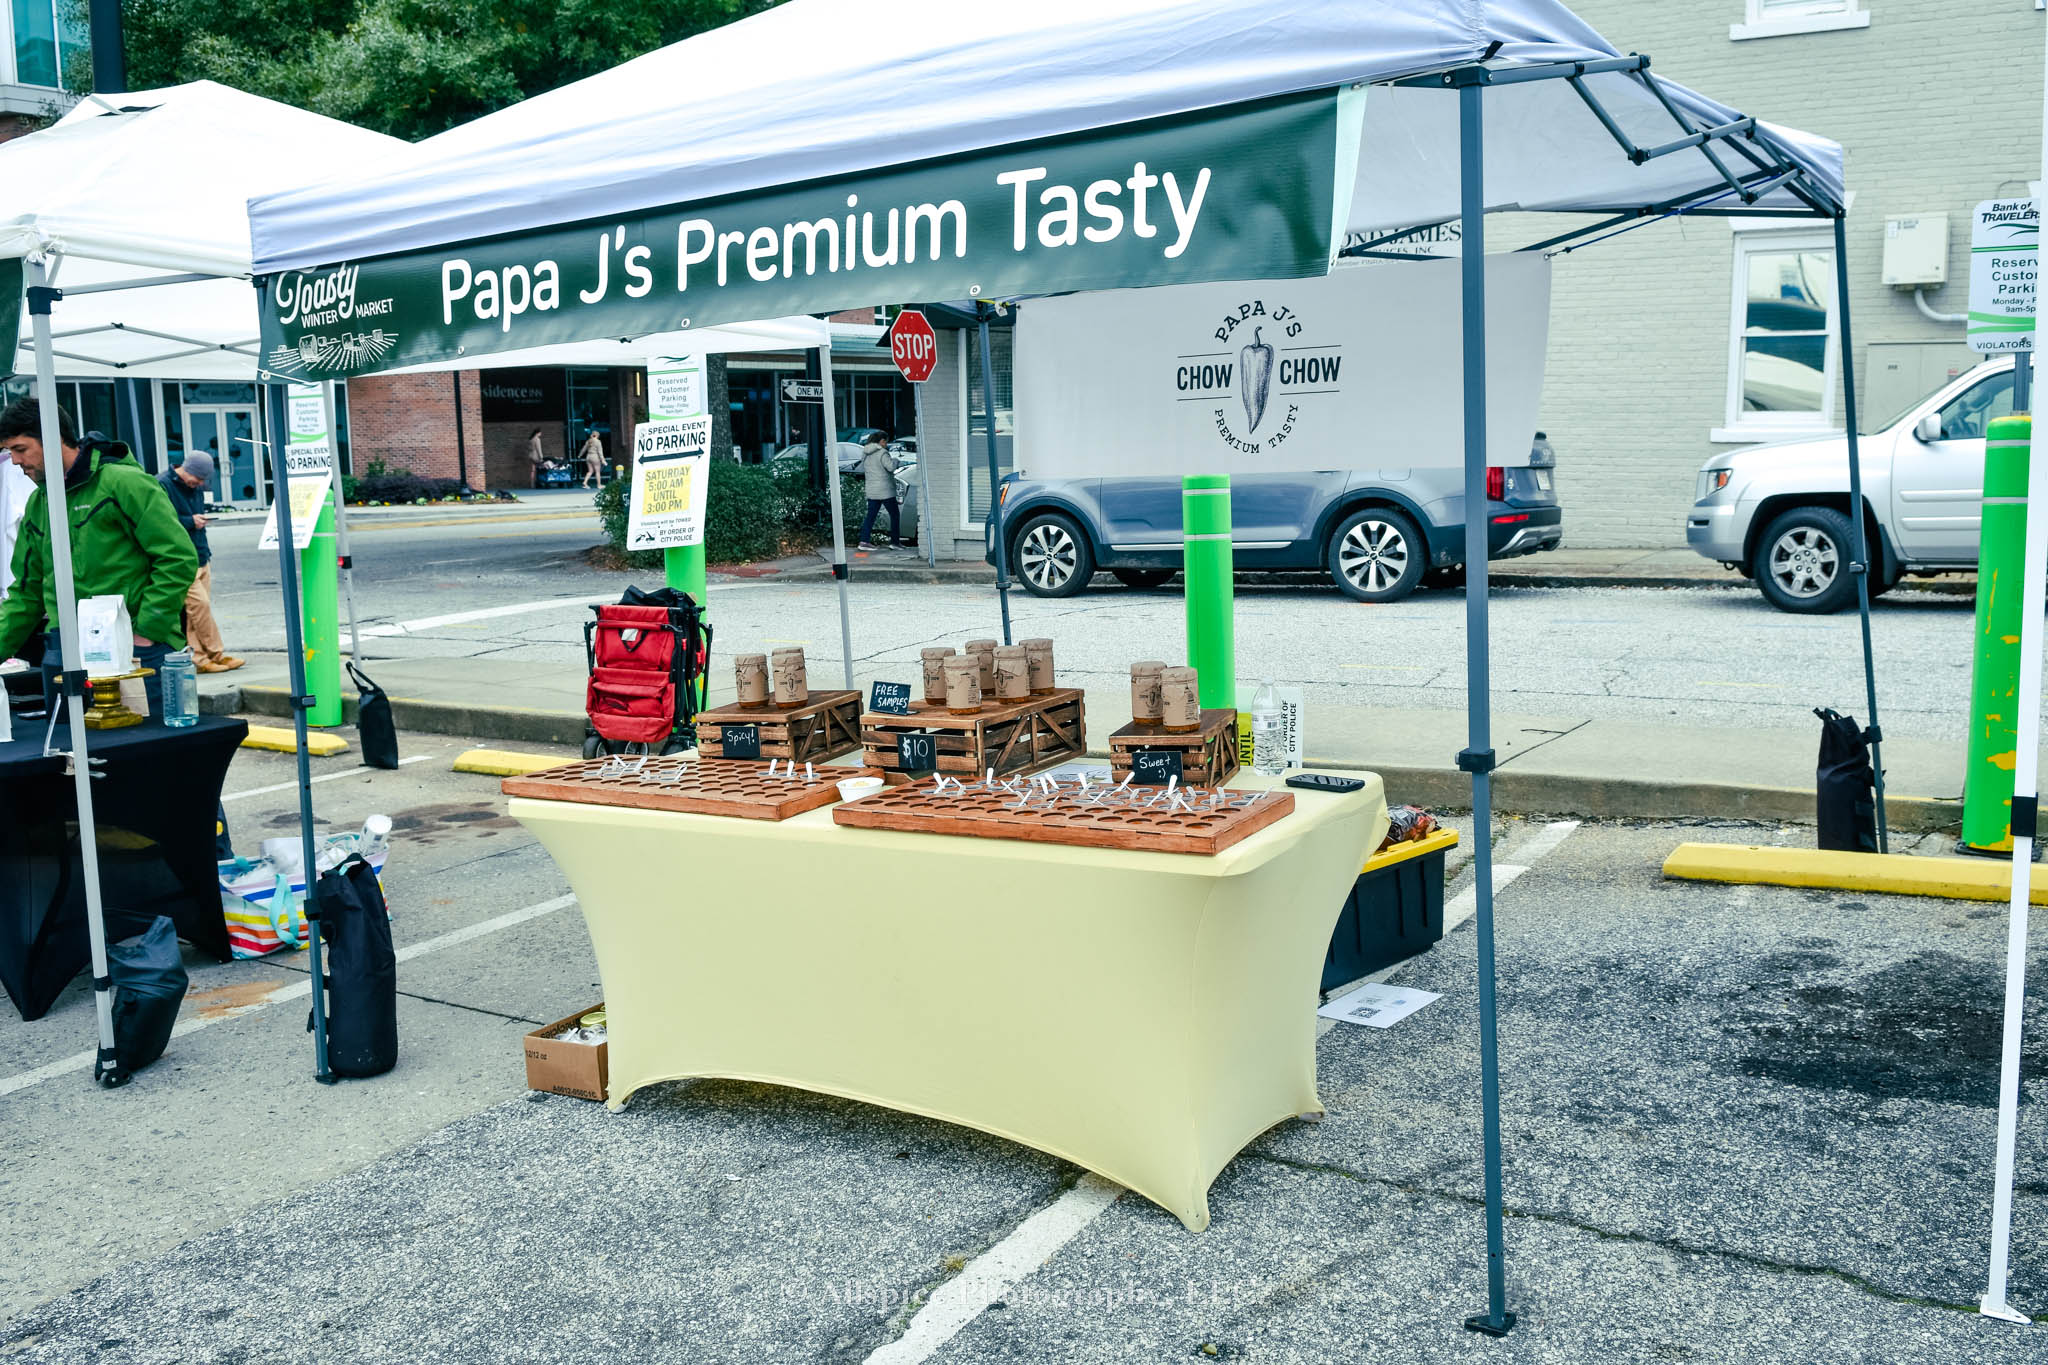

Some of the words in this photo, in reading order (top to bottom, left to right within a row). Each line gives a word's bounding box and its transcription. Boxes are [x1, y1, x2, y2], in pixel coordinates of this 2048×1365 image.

[1992, 203, 2018, 212] Bank
[443, 260, 560, 331] Papa
[580, 226, 653, 304] J's
[678, 195, 967, 292] Premium
[997, 162, 1212, 259] Tasty
[276, 262, 360, 324] Toasty
[1992, 298, 2025, 306] Monday
[301, 309, 339, 328] WINTER
[354, 298, 394, 319] MARKET
[1214, 300, 1267, 344] PAPA
[1272, 305, 1303, 338] J'S
[894, 332, 934, 360] STOP
[1976, 340, 2032, 350] VIOLATORS
[656, 376, 689, 386] Reserved
[1176, 363, 1233, 391] CHOW
[1279, 356, 1342, 385] CHOW
[657, 386, 690, 394] Customer
[797, 386, 811, 396] ONE
[648, 425, 680, 436] SPECIAL
[682, 421, 707, 432] EVENT
[1214, 408, 1261, 454] PREMIUM
[1268, 404, 1299, 449] TASTY
[638, 438, 653, 453] NO
[656, 431, 706, 451] PARKING
[290, 448, 313, 456] SPECIAL
[297, 455, 332, 470] PARKING
[645, 465, 691, 482] SATURDAY
[649, 480, 668, 492] 5:00
[669, 477, 684, 489] AM
[653, 489, 677, 502] UNTIL
[647, 502, 667, 514] 3:00
[668, 499, 683, 510] PM
[674, 534, 693, 542] POLICE
[875, 683, 899, 697] FREE
[877, 696, 908, 709] SAMPLES
[726, 728, 755, 746] Spicy!
[902, 736, 929, 759] $10
[1139, 755, 1171, 769] Sweet
